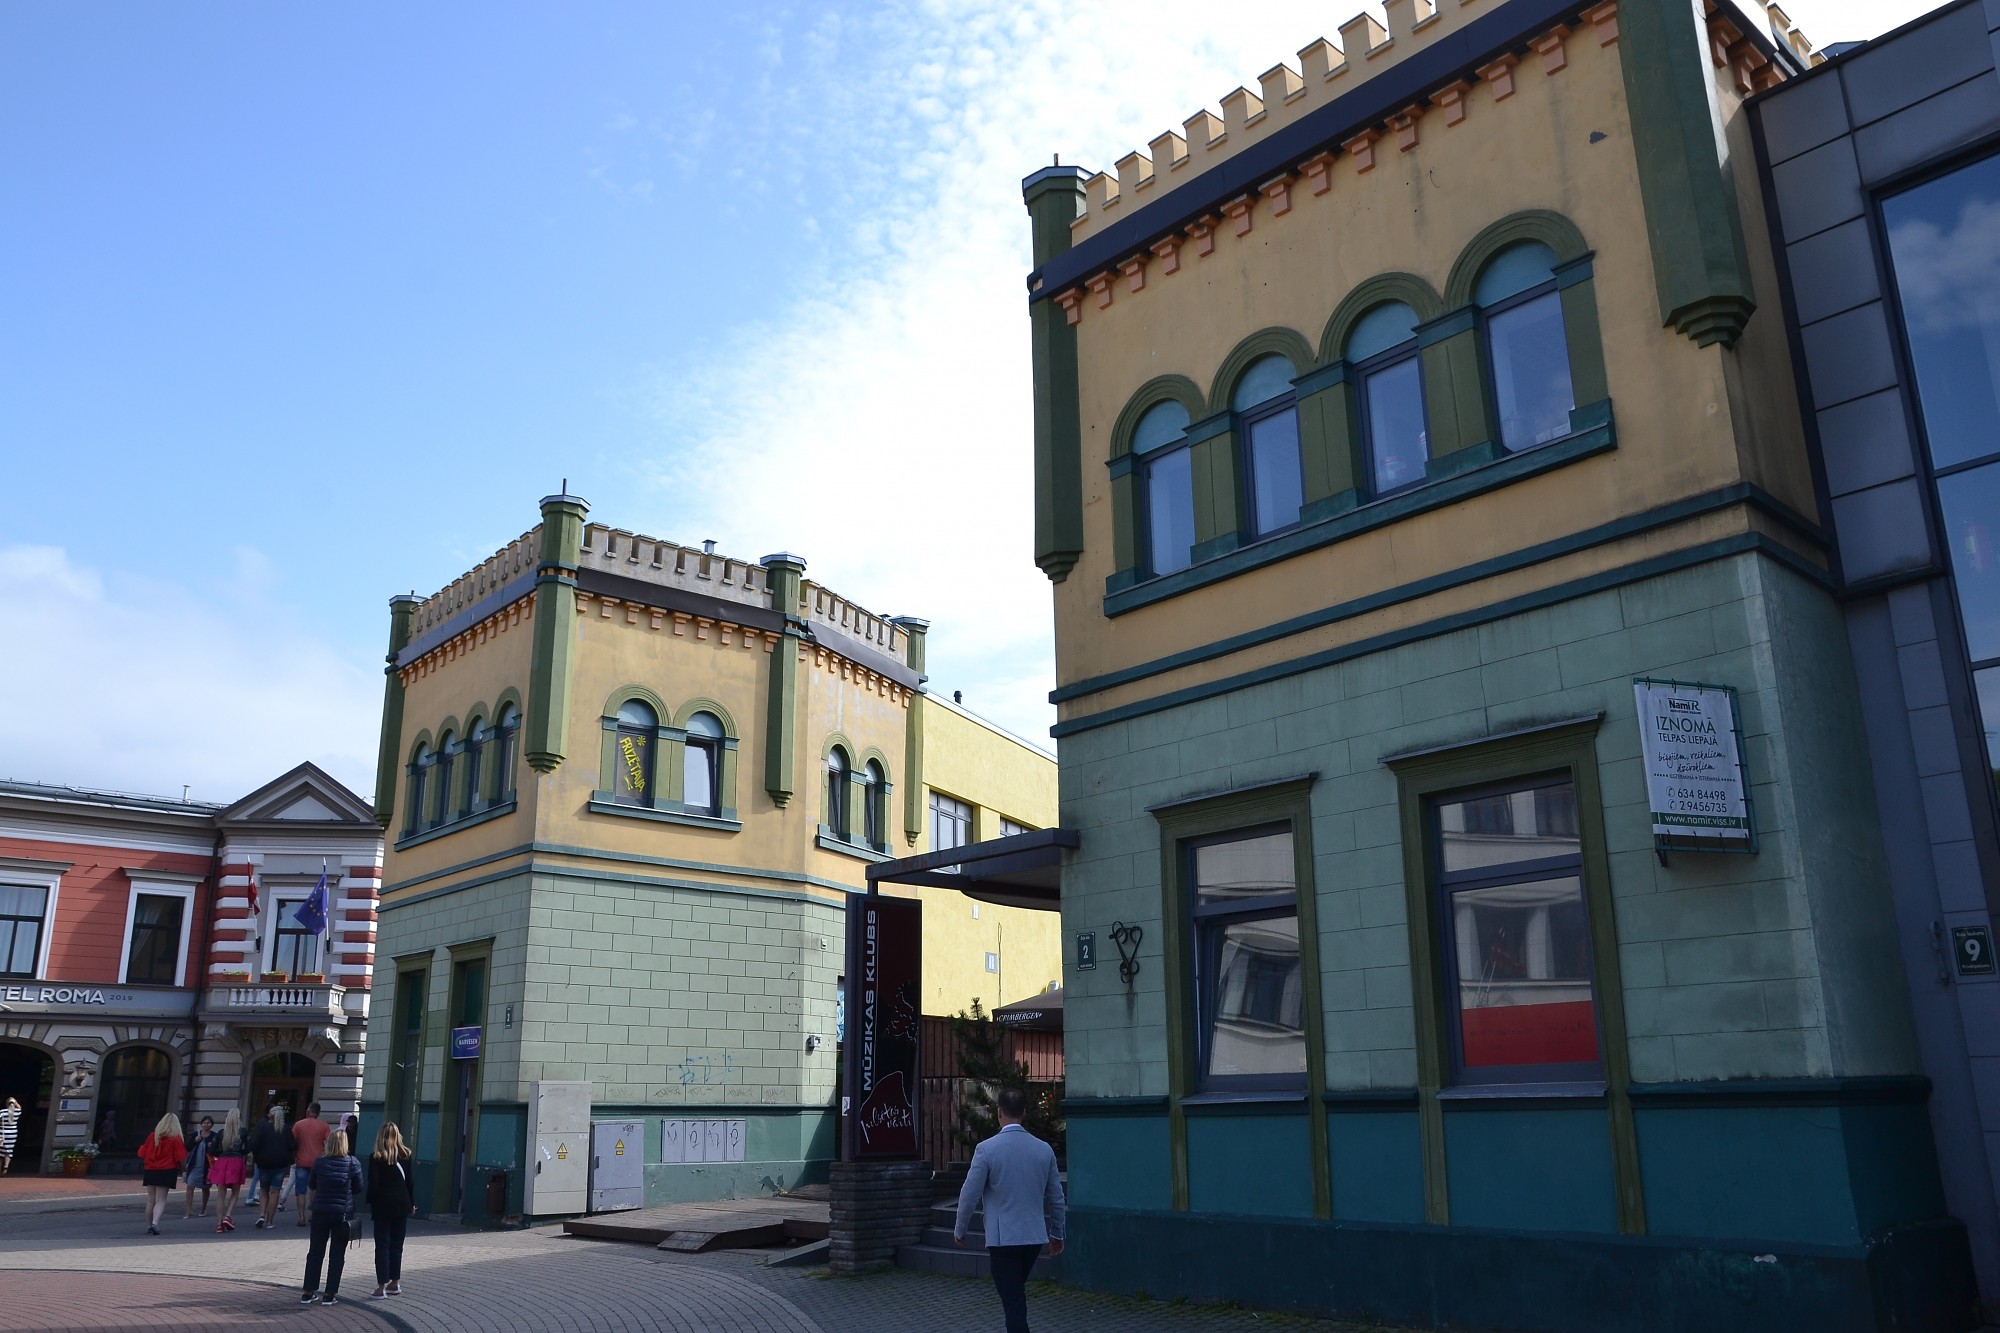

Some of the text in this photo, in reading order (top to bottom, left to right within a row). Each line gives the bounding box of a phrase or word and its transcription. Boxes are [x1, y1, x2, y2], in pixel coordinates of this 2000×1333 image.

[1656, 715, 1716, 734] IZNOMĀ
[1658, 733, 1718, 746] TELPAS LIEPĀJĀ
[1677, 788, 1726, 801] 634 84498
[1665, 815, 1736, 826] www.namir.viss.lv
[1082, 944, 1089, 959] 2
[1965, 939, 1980, 961] 9
[40, 987, 106, 1004] ROMA
[862, 910, 876, 1091] MŪZIKAS KLUBS
